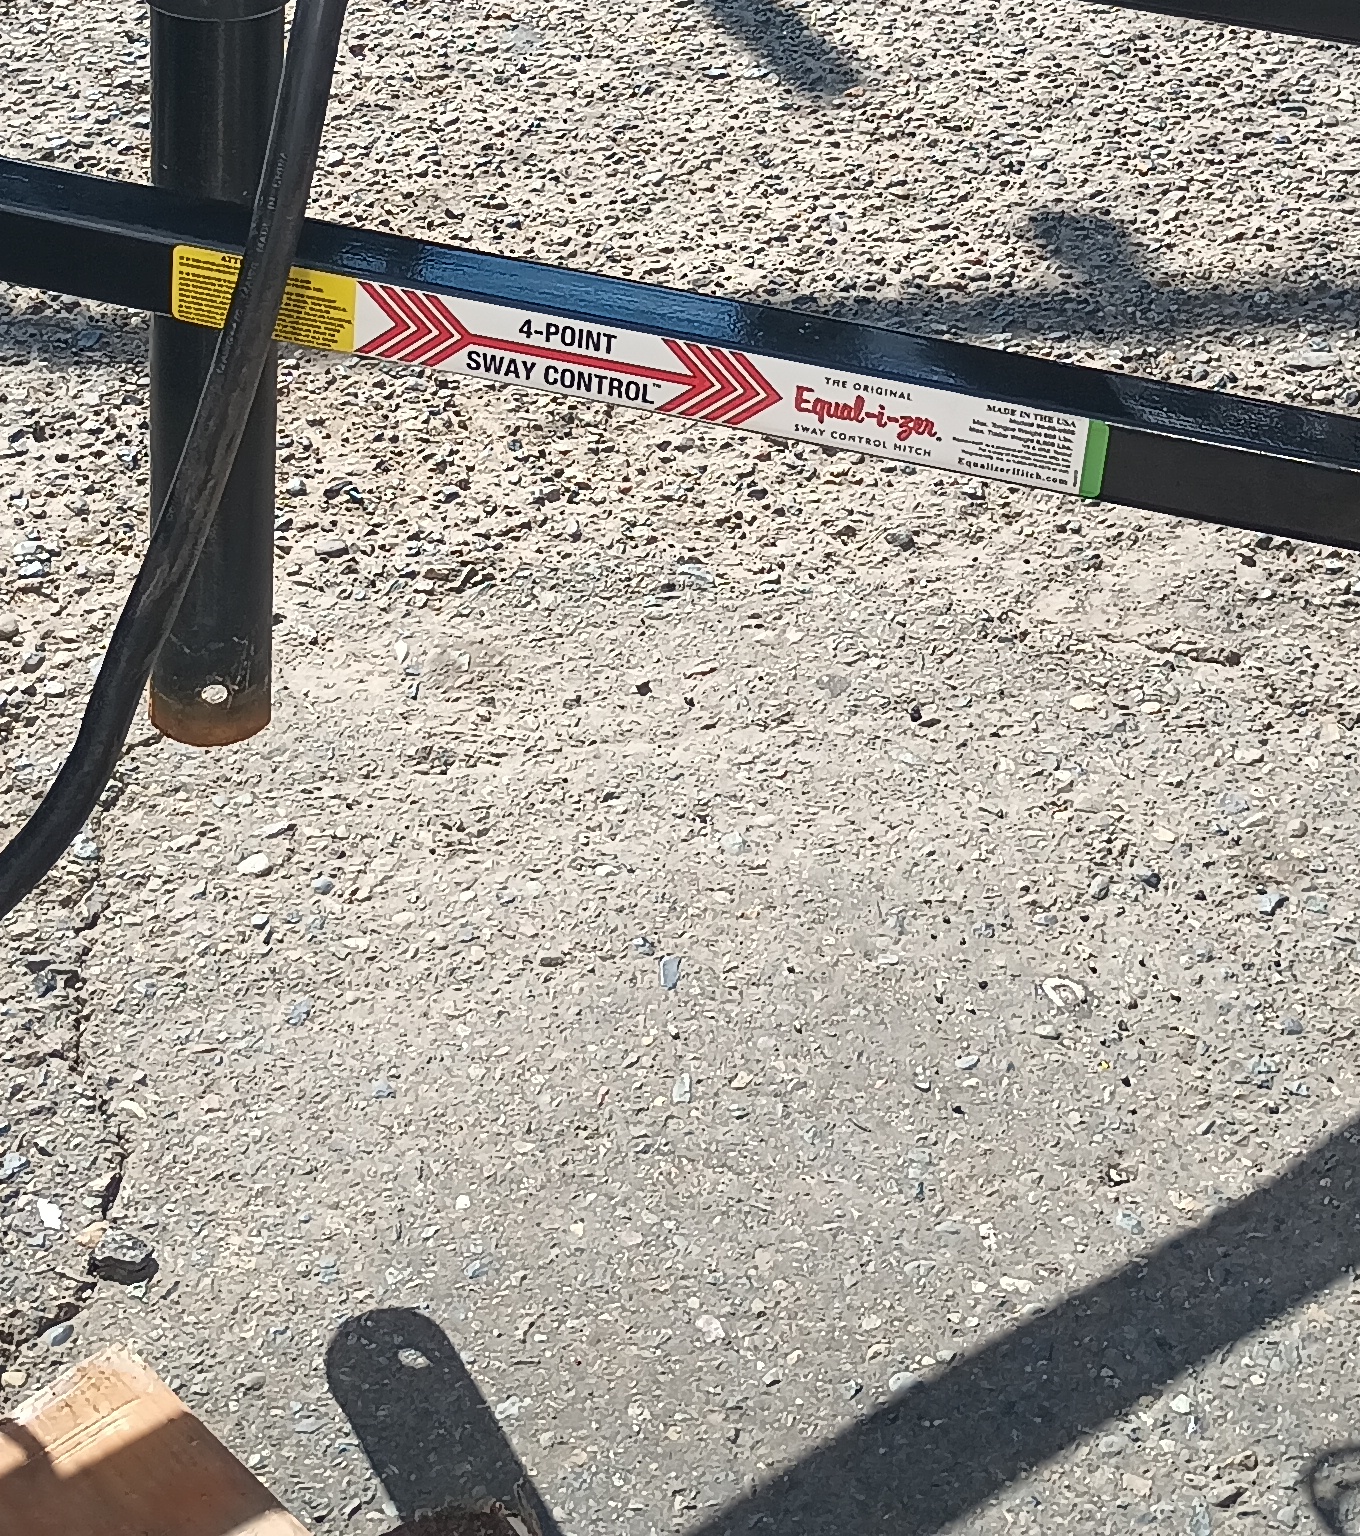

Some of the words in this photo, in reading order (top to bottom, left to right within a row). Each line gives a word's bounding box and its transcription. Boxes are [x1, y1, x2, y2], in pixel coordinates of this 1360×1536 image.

[518, 318, 618, 355] 4-POINT
[466, 350, 537, 381] SWAY
[824, 376, 848, 389] THE
[852, 382, 914, 402] ORIGINAL
[985, 404, 1018, 417] MADE
[1019, 409, 1031, 420] IN
[1032, 413, 1055, 424] THE
[1056, 417, 1077, 429] USA
[794, 423, 826, 437] SWAY
[830, 430, 888, 449] CONTROL
[893, 442, 932, 457] HITCH
